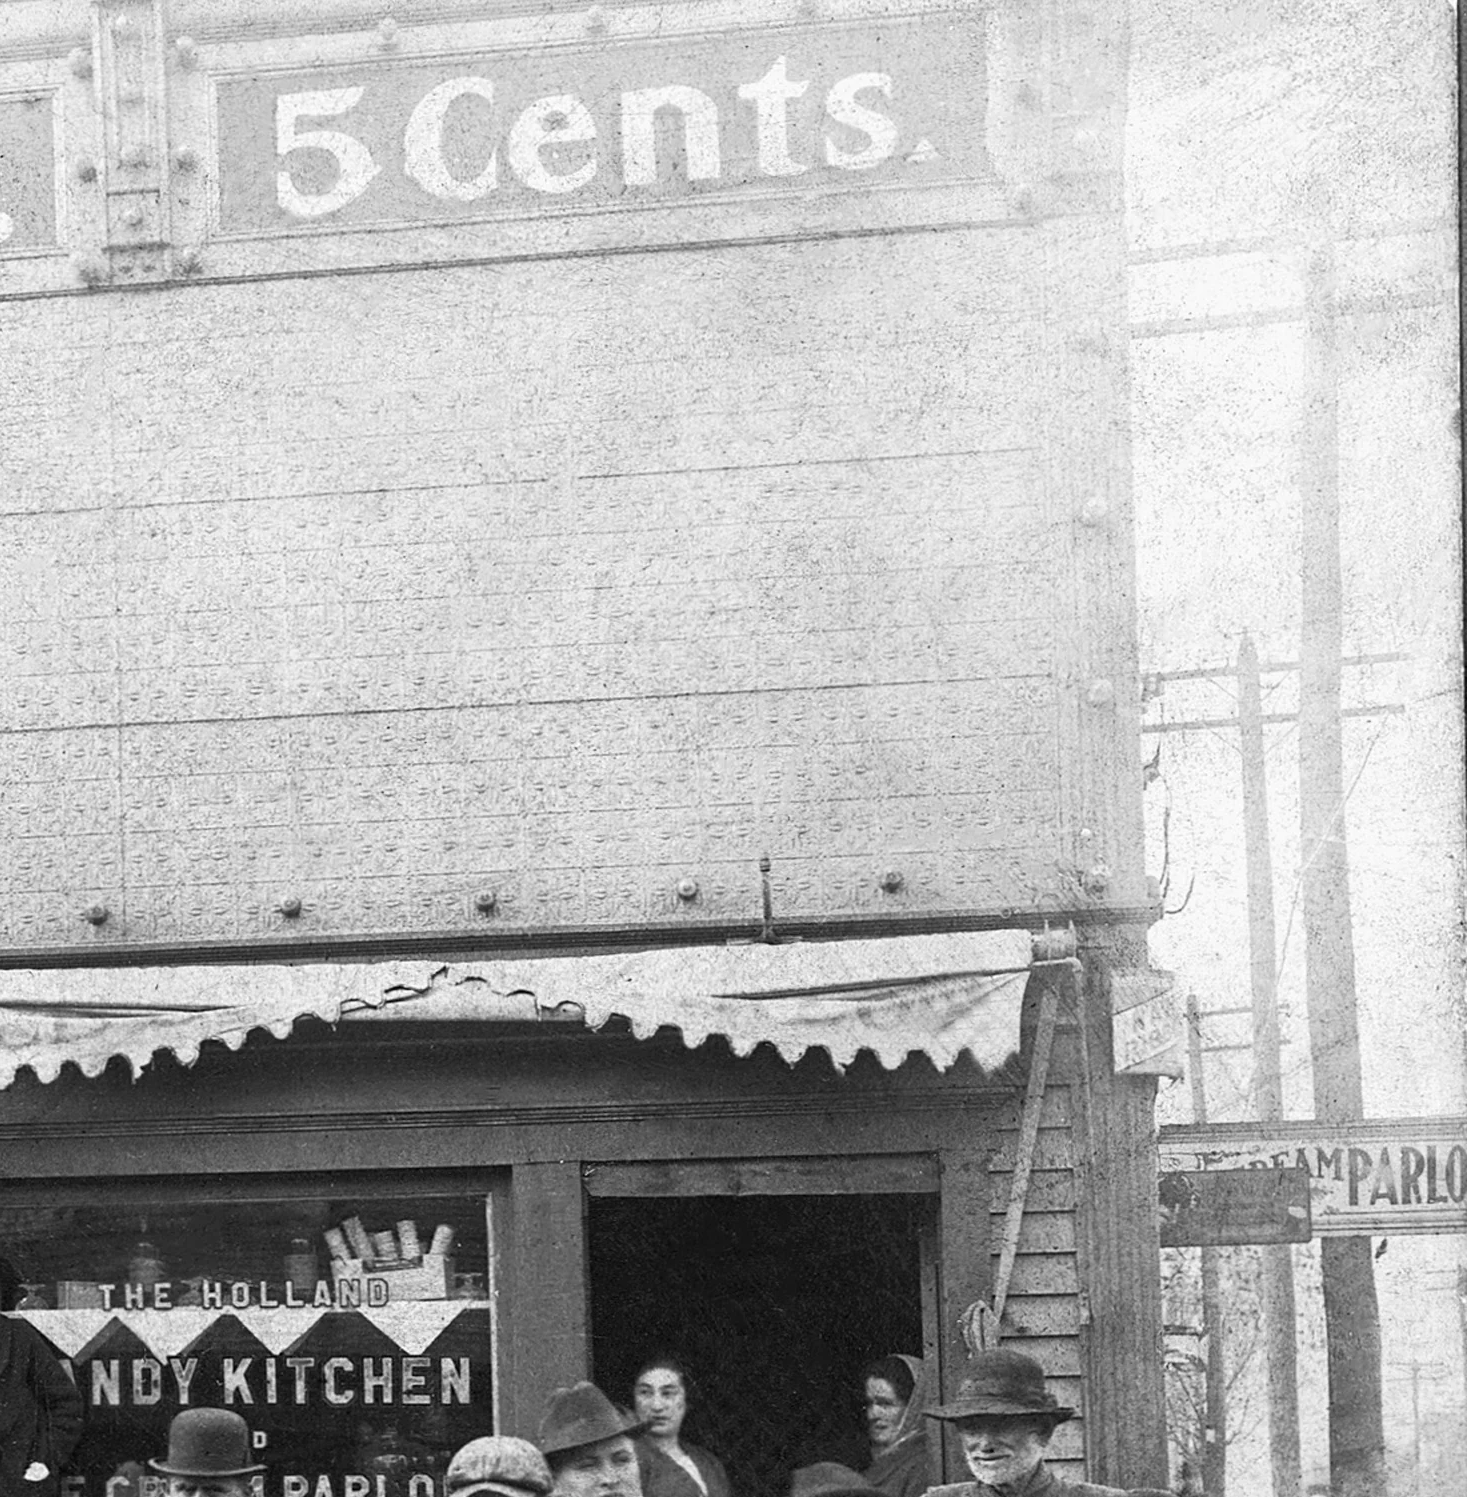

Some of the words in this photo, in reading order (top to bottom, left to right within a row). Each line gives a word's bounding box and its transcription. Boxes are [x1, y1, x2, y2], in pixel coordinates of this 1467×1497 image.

[275, 86, 379, 217] 5
[403, 55, 942, 200] Cents.
[98, 1282, 173, 1310] THE
[202, 1278, 391, 1310] HOLLAND
[60, 1357, 198, 1406] NDY
[223, 1357, 471, 1406] KITCHEN
